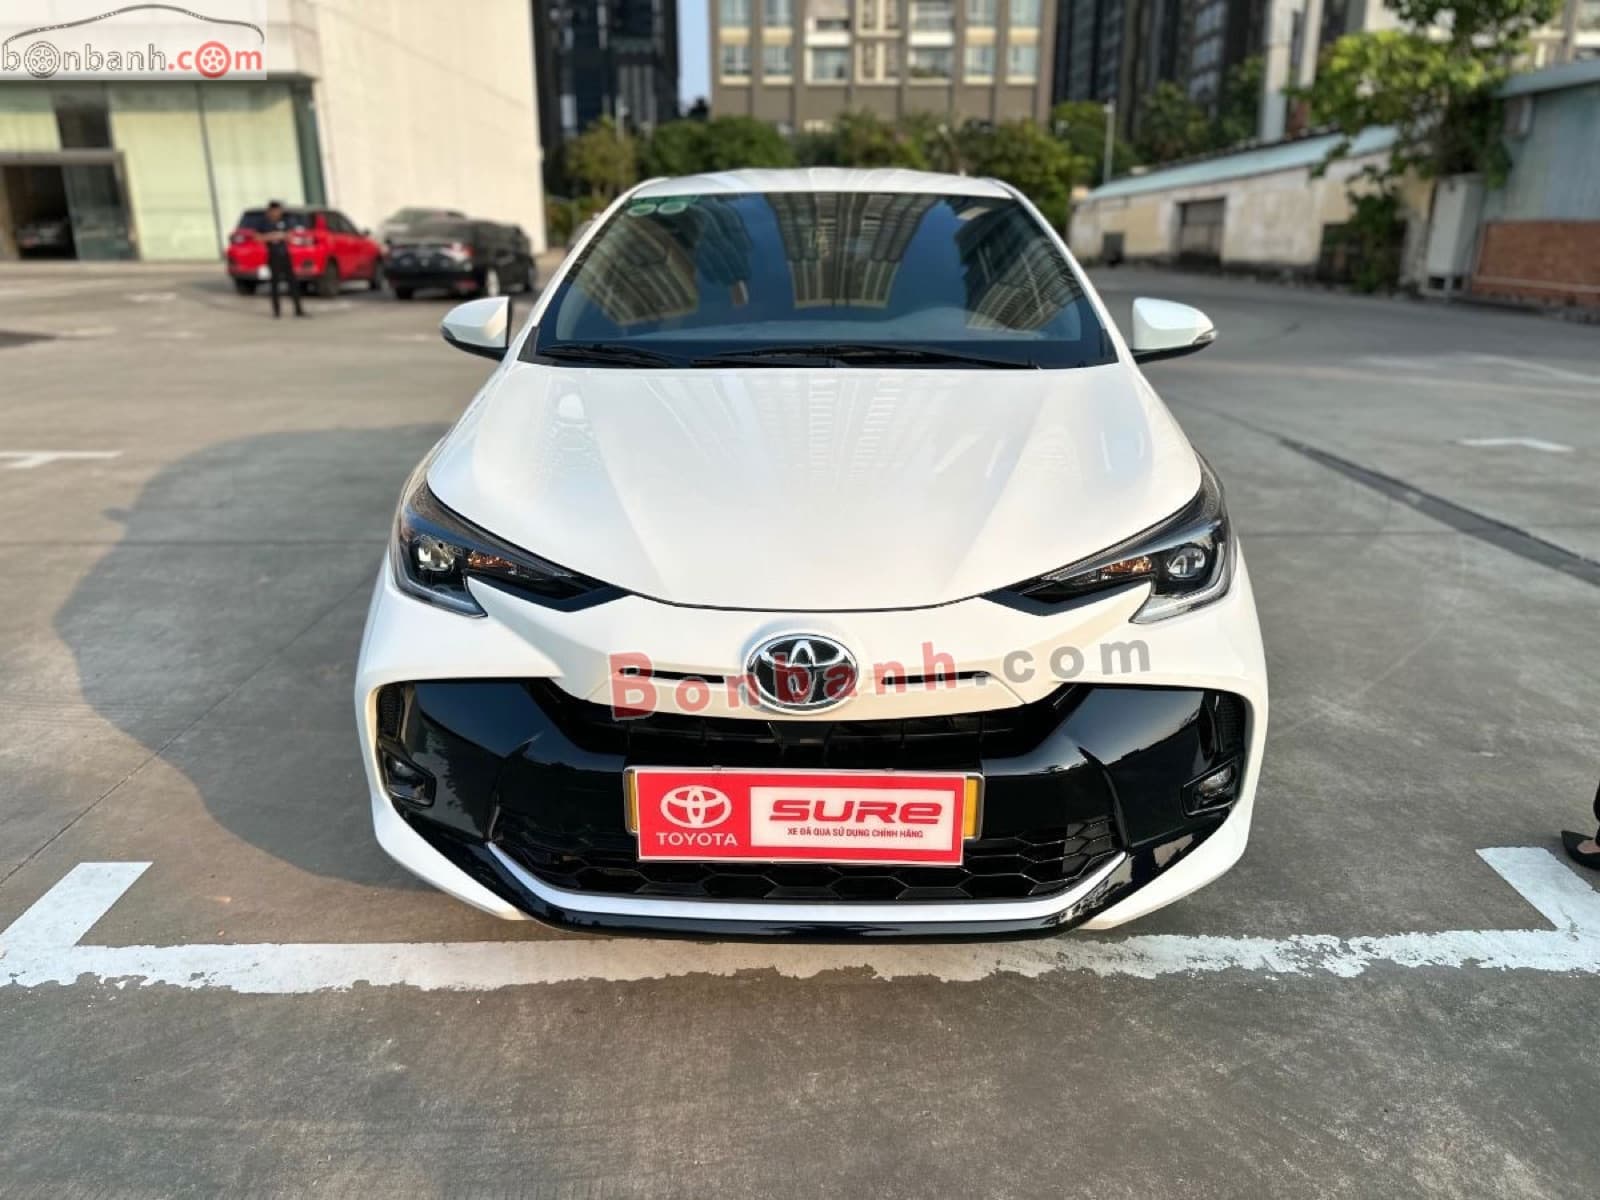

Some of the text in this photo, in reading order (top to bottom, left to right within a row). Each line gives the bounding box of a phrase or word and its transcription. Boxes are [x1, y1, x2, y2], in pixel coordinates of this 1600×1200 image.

[787, 827, 798, 835] XE
[813, 828, 831, 837] QUA
[656, 831, 738, 848] TOYOTA
